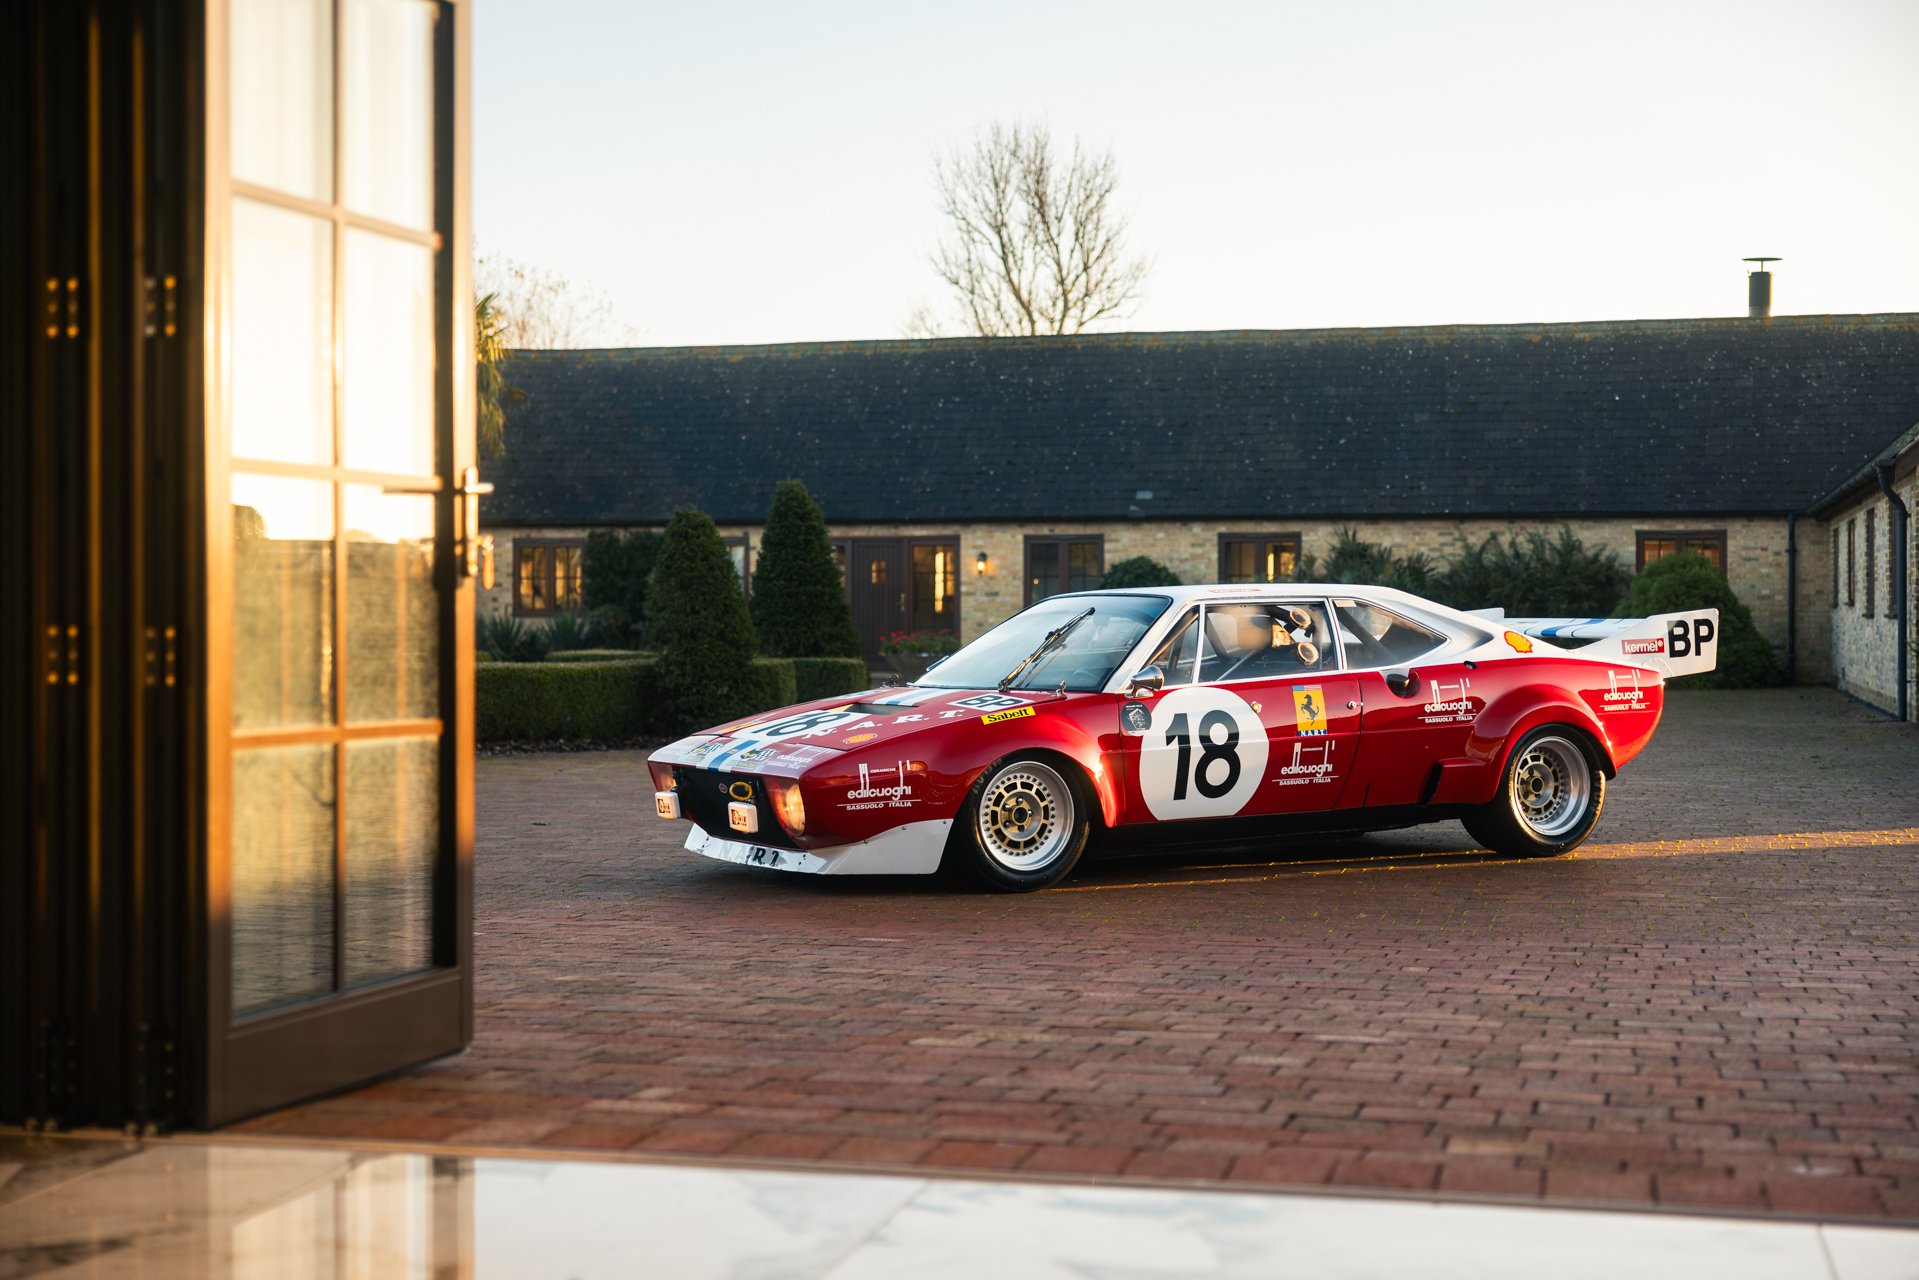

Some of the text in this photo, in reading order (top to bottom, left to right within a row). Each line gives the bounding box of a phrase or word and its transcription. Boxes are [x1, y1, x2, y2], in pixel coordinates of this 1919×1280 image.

[1668, 619, 1714, 658] BP
[957, 695, 1024, 708] BP
[751, 711, 851, 736] 18
[987, 708, 1030, 722] Sabelt
[1165, 709, 1241, 800] 18
[846, 802, 884, 811] SASSUOLO
